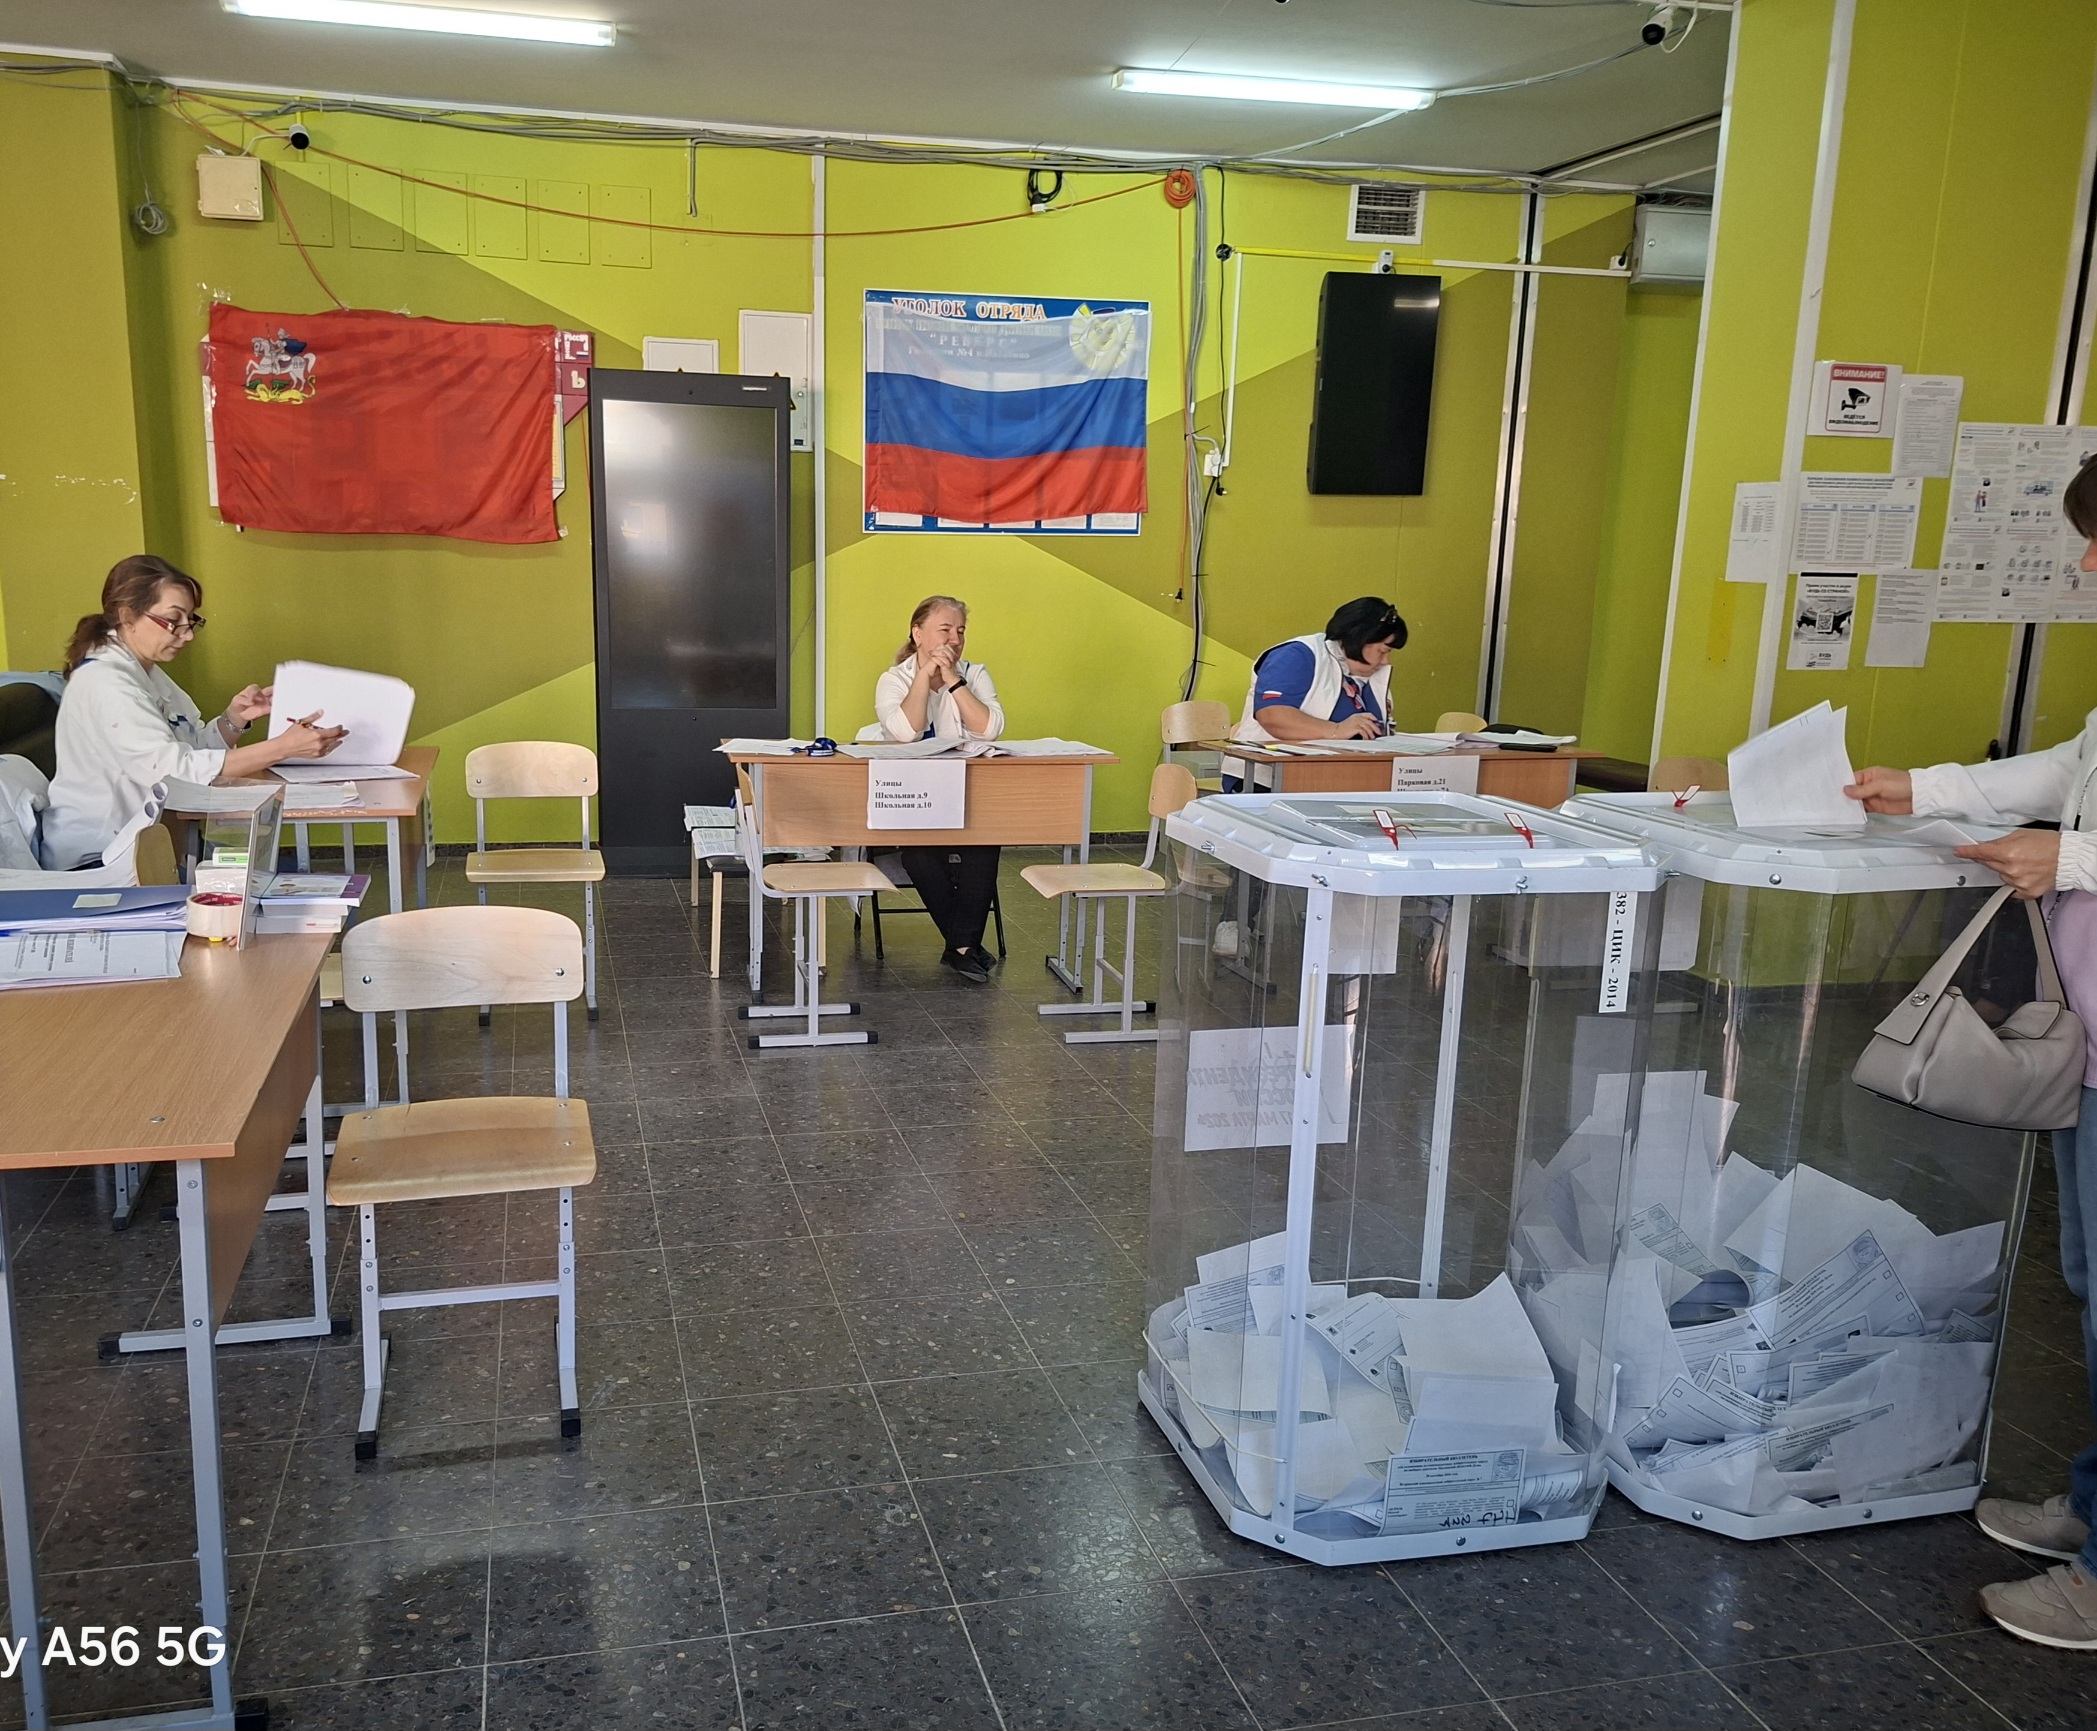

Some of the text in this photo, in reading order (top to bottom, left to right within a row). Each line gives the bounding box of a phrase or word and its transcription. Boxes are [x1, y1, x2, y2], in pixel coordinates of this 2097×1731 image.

[892, 298, 1048, 322] УГОЛОК ОТРЯДА
[1833, 369, 1886, 379] ВНИМАНИЕ!
[1398, 767, 1423, 775] Улицы
[875, 779, 902, 787] Улицы
[1397, 778, 1446, 788] Парковая д.21
[875, 791, 928, 800] Школьная д.9
[875, 801, 932, 810] Школьная д.10
[1610, 929, 1624, 964] ЦИК
[1605, 977, 1619, 1008] 2014
